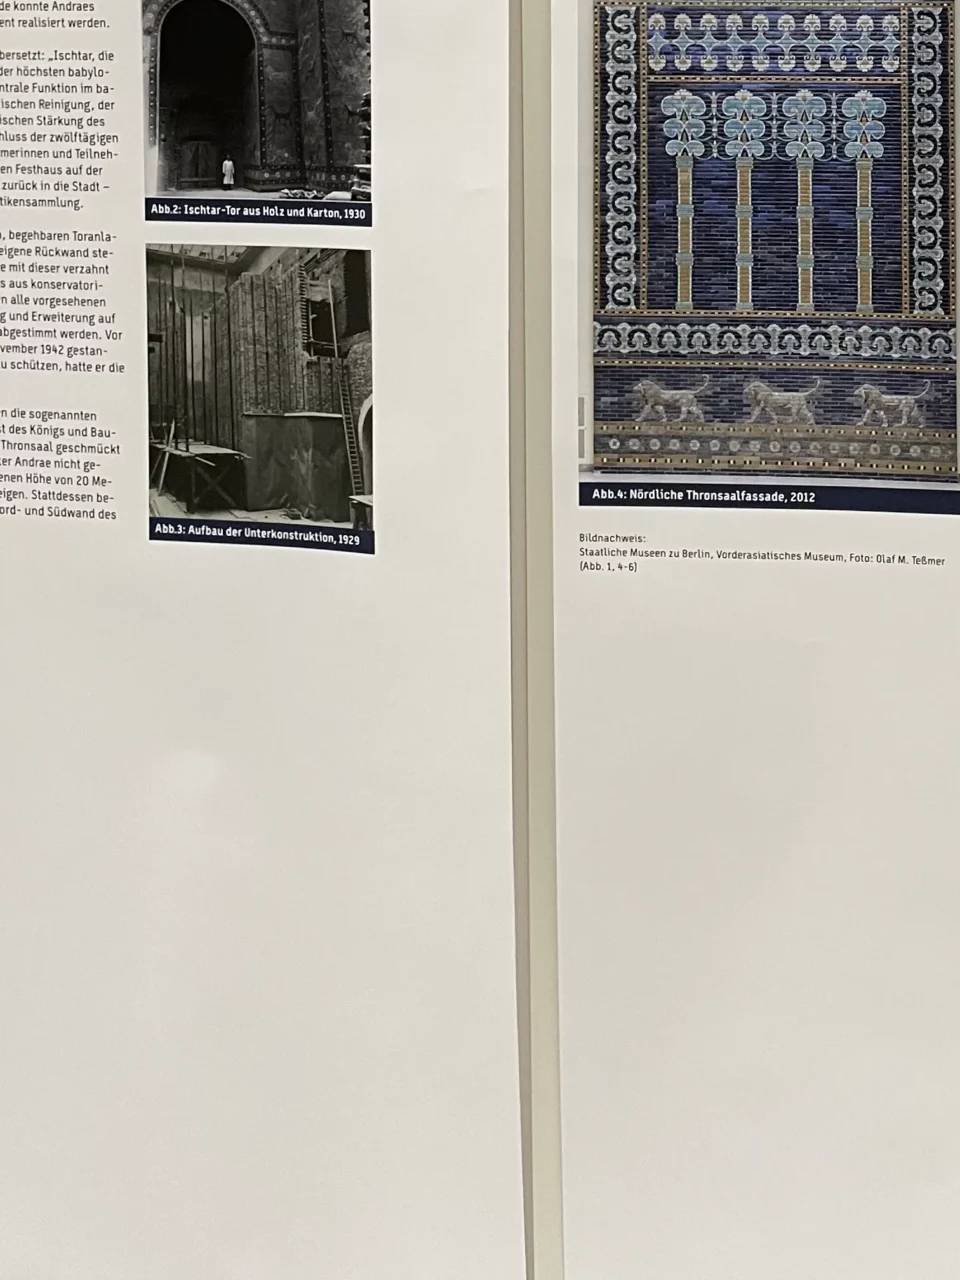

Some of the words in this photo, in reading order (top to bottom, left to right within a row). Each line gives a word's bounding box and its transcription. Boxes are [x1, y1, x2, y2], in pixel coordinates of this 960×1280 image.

[1, 179, 38, 191] zurück
[40, 179, 51, 191] in
[53, 180, 70, 192] die
[71, 180, 100, 192] Stadt
[150, 203, 182, 215] Abb.2:
[183, 204, 241, 216] Ischtar-Tor
[242, 207, 261, 216] aus
[262, 205, 285, 217] Holz
[286, 207, 305, 217] und
[306, 207, 343, 220] Karton,
[344, 208, 366, 220] 1930
[0, 439, 54, 453] Thronsaal
[55, 442, 121, 456] geschmückt
[592, 488, 628, 499] Abb.4:
[629, 488, 684, 501] Nördliche
[685, 489, 788, 504] Thronsaalfassade,
[790, 491, 816, 503] 2012
[154, 523, 186, 535] Abb.3:
[187, 524, 224, 536] Aufbau
[225, 526, 243, 537] der
[244, 527, 337, 545] Unterkonstruktion,
[338, 534, 360, 546] 1929
[579, 532, 647, 544] Bildnachweis:
[579, 546, 628, 558] Staatliche
[629, 547, 667, 558] Museen
[668, 550, 680, 559] zu
[681, 548, 714, 560] Berlin,
[715, 549, 802, 561] Vorderasiatisches
[803, 551, 847, 563] Museum,
[849, 552, 874, 563] Foto:
[875, 553, 896, 564] Olaf
[897, 555, 910, 565] M.
[911, 555, 946, 567] Teßmer
[579, 560, 605, 572] (Abb.
[606, 561, 616, 572] 1,
[617, 561, 638, 573] 4-6)
